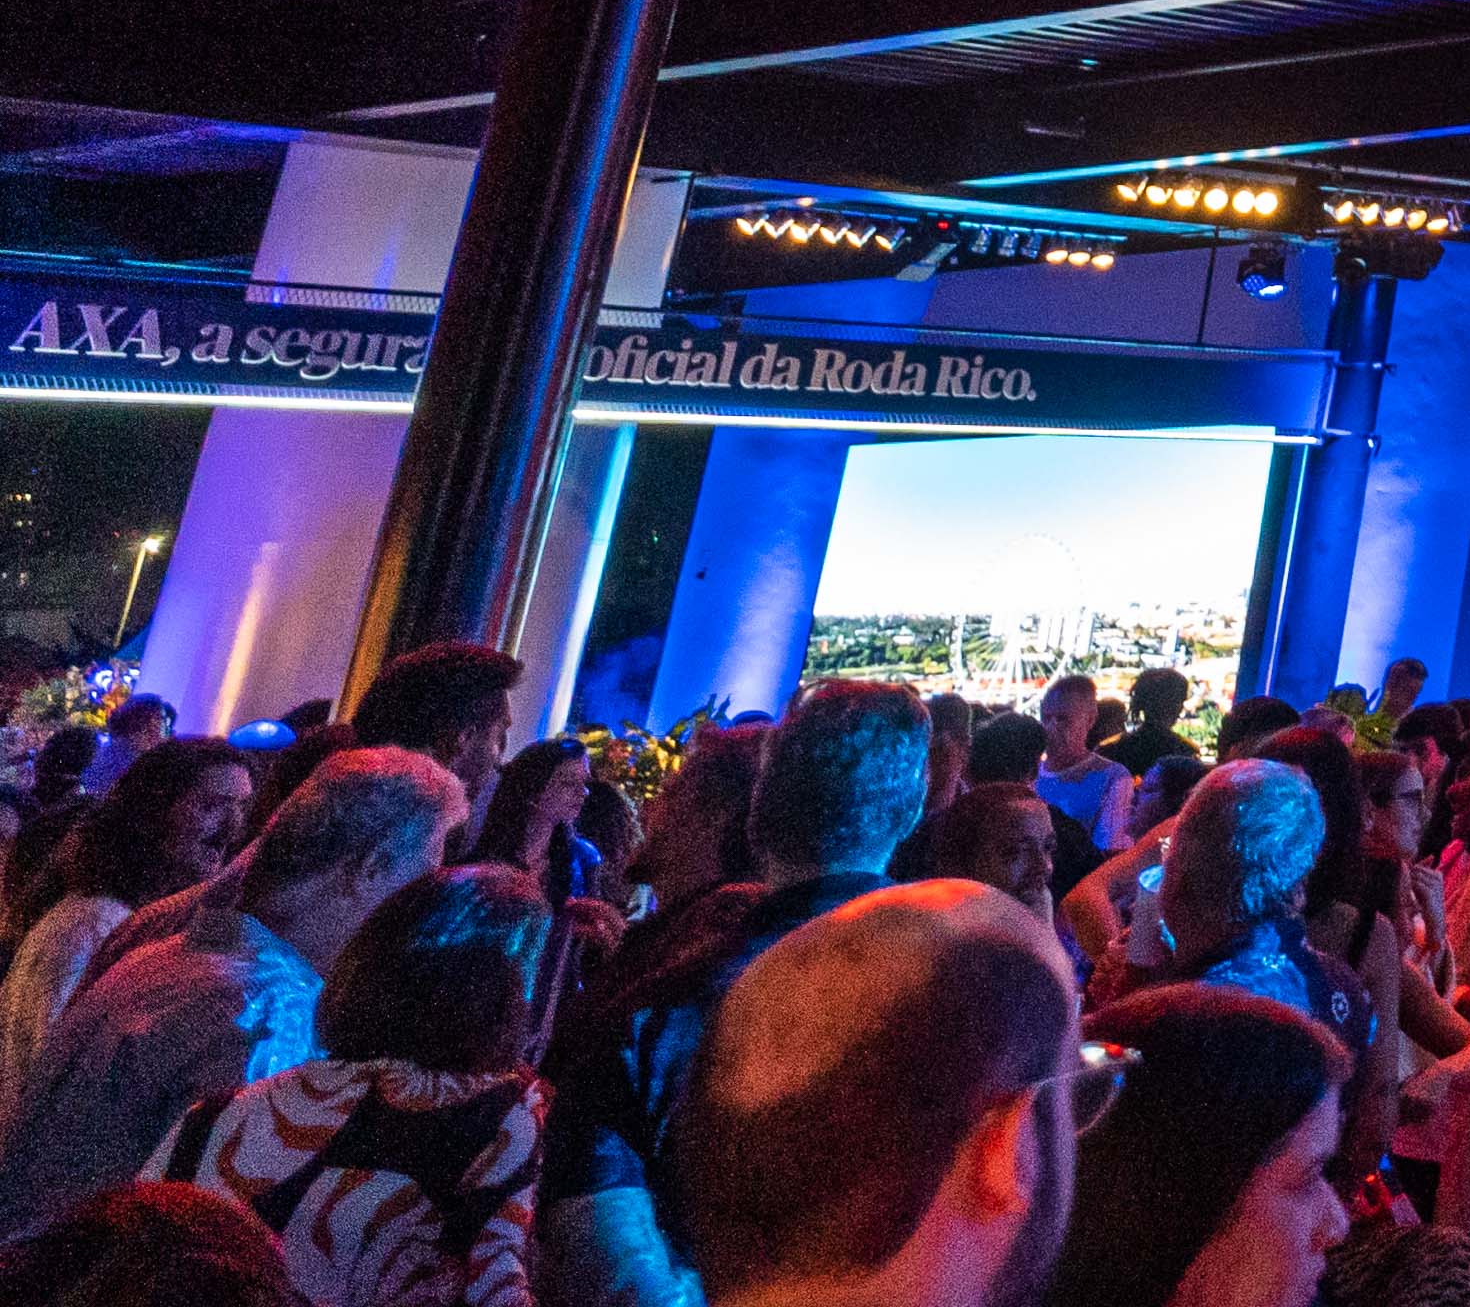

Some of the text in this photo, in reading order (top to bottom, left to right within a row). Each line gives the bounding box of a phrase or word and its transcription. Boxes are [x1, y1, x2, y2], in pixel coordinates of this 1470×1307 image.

[8, 300, 1037, 402] AXA, a segura oficial da Roda Rico.
